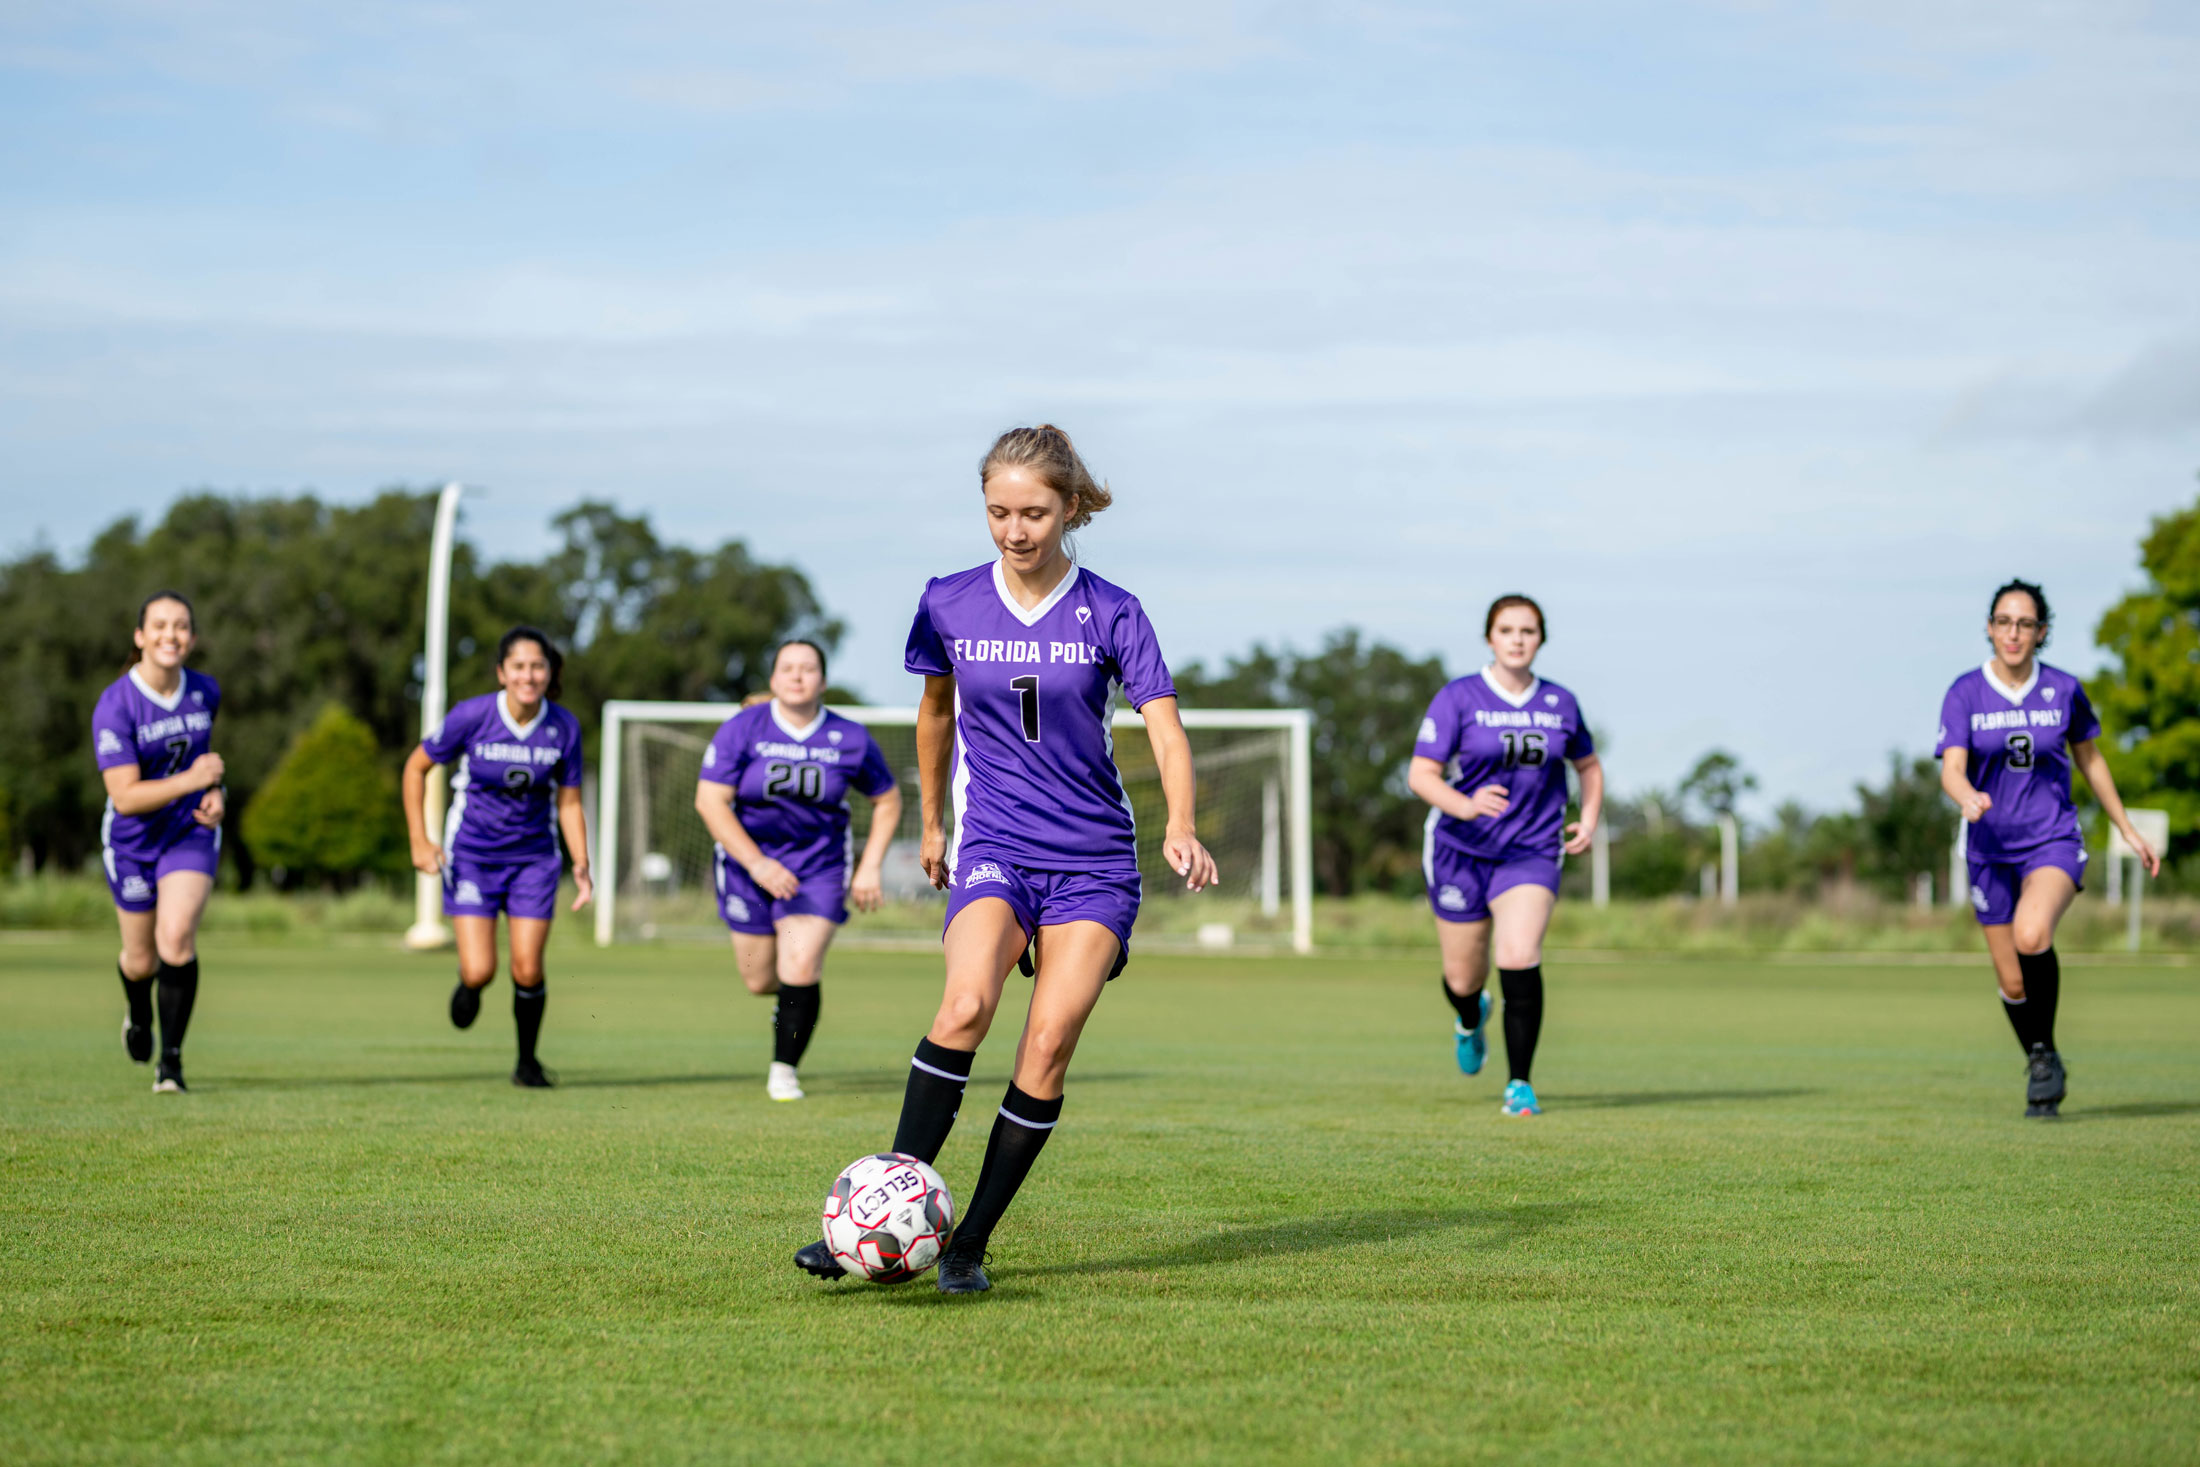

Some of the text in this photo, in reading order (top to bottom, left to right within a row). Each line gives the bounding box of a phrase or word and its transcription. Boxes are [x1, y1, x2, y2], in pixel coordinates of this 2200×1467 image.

[954, 639, 1041, 663] FLORIDA
[1010, 674, 1040, 743] 1
[1475, 710, 1562, 730] FLORIDA POLY
[1971, 709, 2062, 731] FLORIDA POLY
[138, 716, 184, 744] FLORIDA
[1498, 729, 1549, 770] 16
[164, 734, 191, 776] 7
[2004, 730, 2035, 773] 3
[762, 759, 825, 802] 20
[857, 1171, 918, 1220] SELECT
